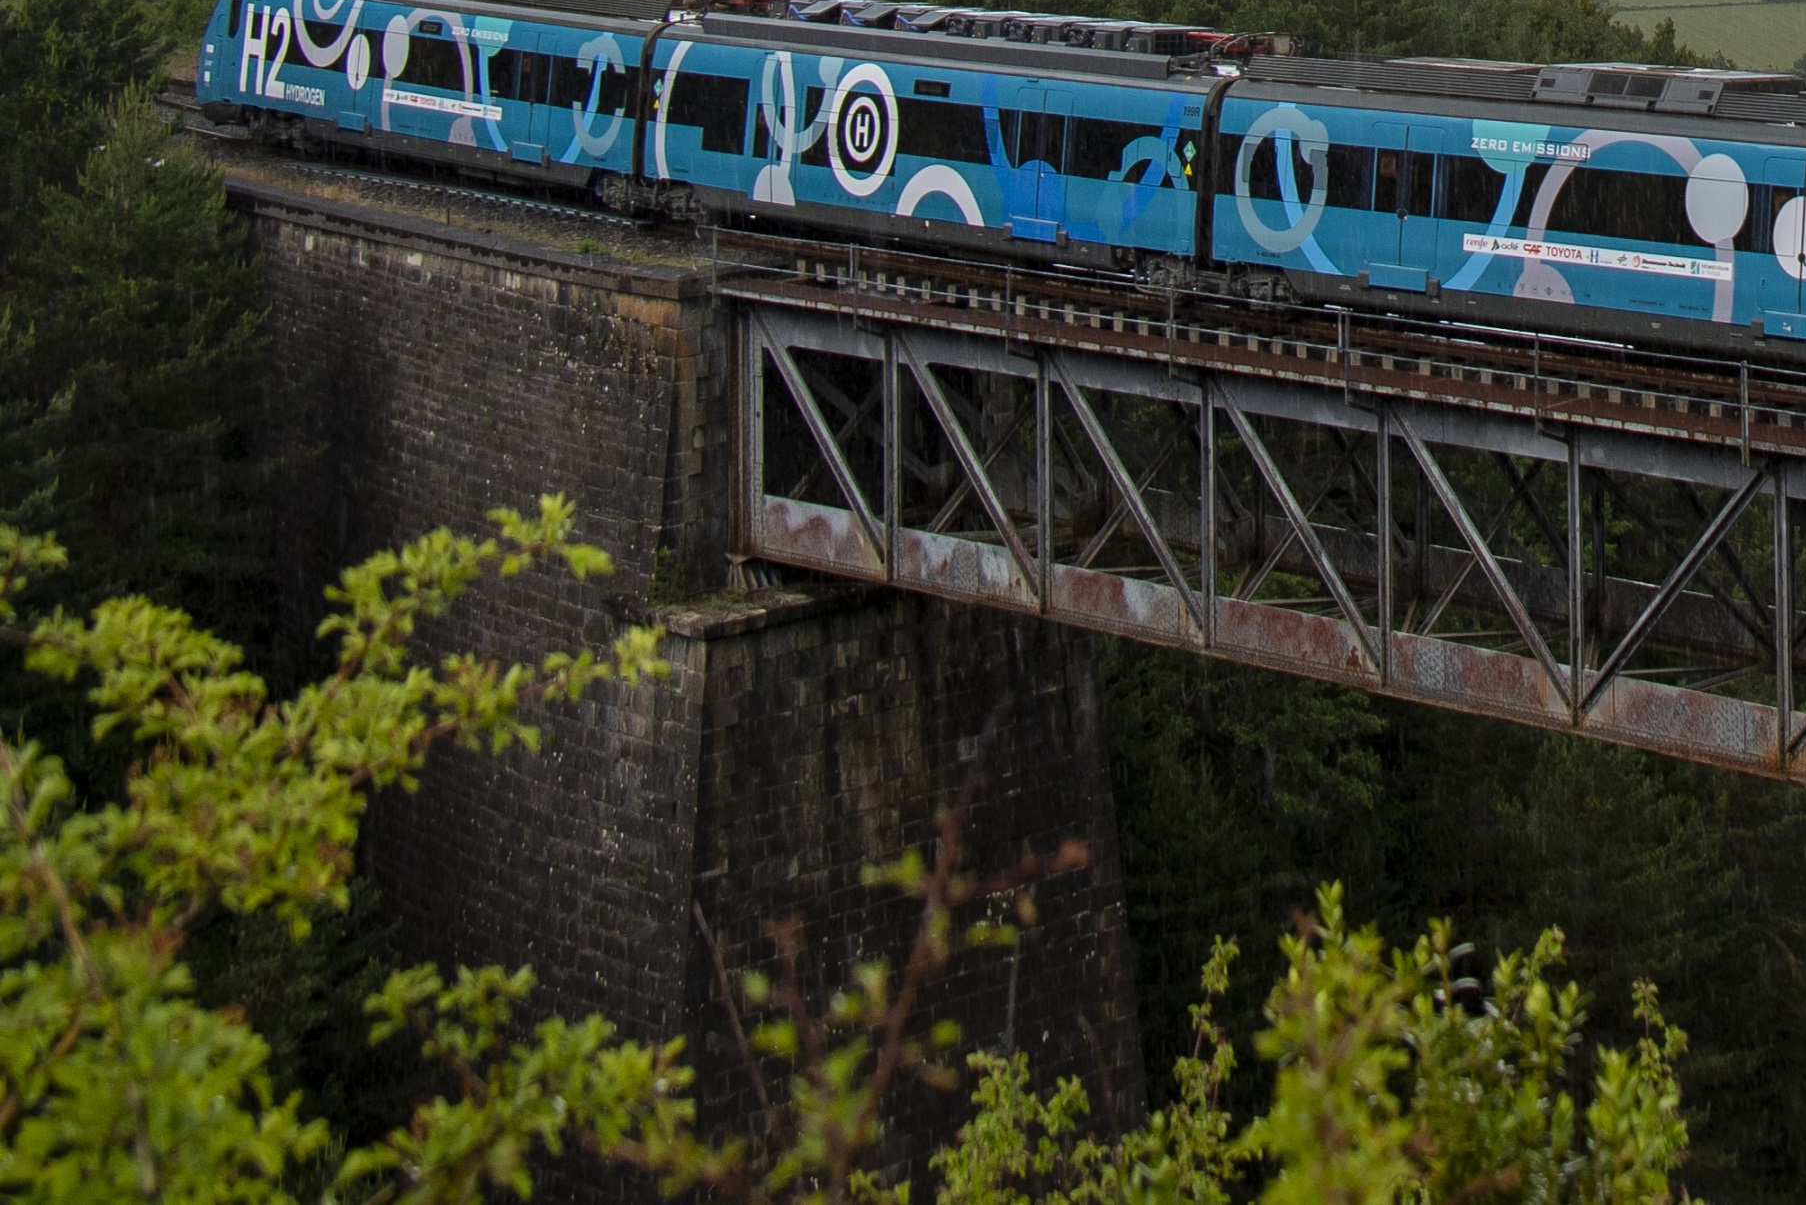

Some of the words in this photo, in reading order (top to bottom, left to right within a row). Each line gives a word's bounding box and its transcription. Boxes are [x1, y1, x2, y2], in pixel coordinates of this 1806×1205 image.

[452, 26, 470, 37] ZERO
[239, 3, 292, 99] H2
[285, 83, 326, 106] HYDROGEN
[855, 113, 870, 147] H
[1470, 137, 1508, 151] ZERO
[1512, 141, 1592, 159] EMISSIONS
[1465, 237, 1488, 250] renfe
[1545, 245, 1583, 260] TOYOTA
